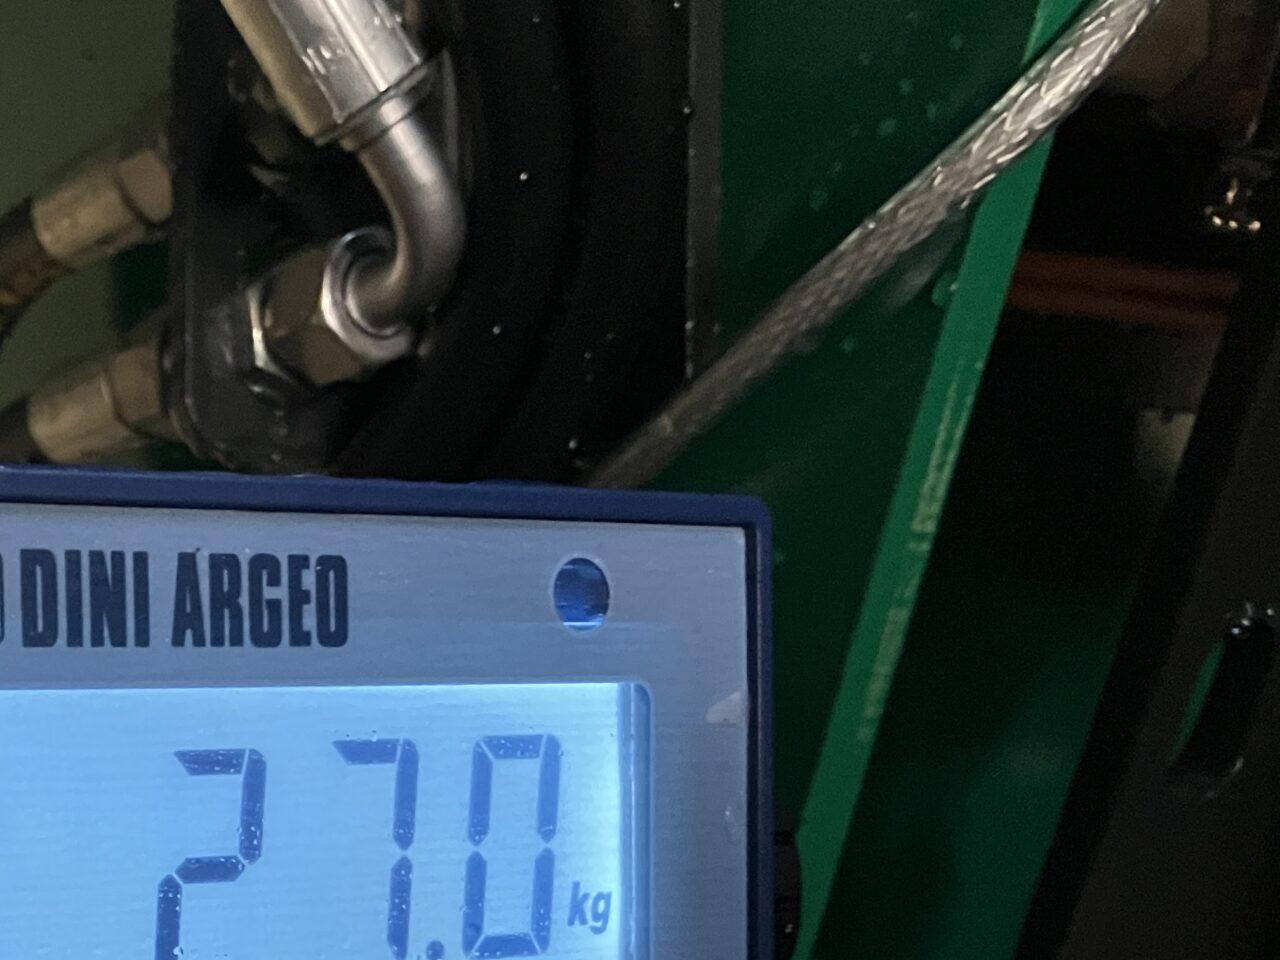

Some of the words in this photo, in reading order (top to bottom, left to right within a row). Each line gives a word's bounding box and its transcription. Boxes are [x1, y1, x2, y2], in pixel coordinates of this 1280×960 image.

[20, 549, 151, 648] DINI
[171, 550, 348, 649] ARGEO
[566, 881, 612, 935] kg
